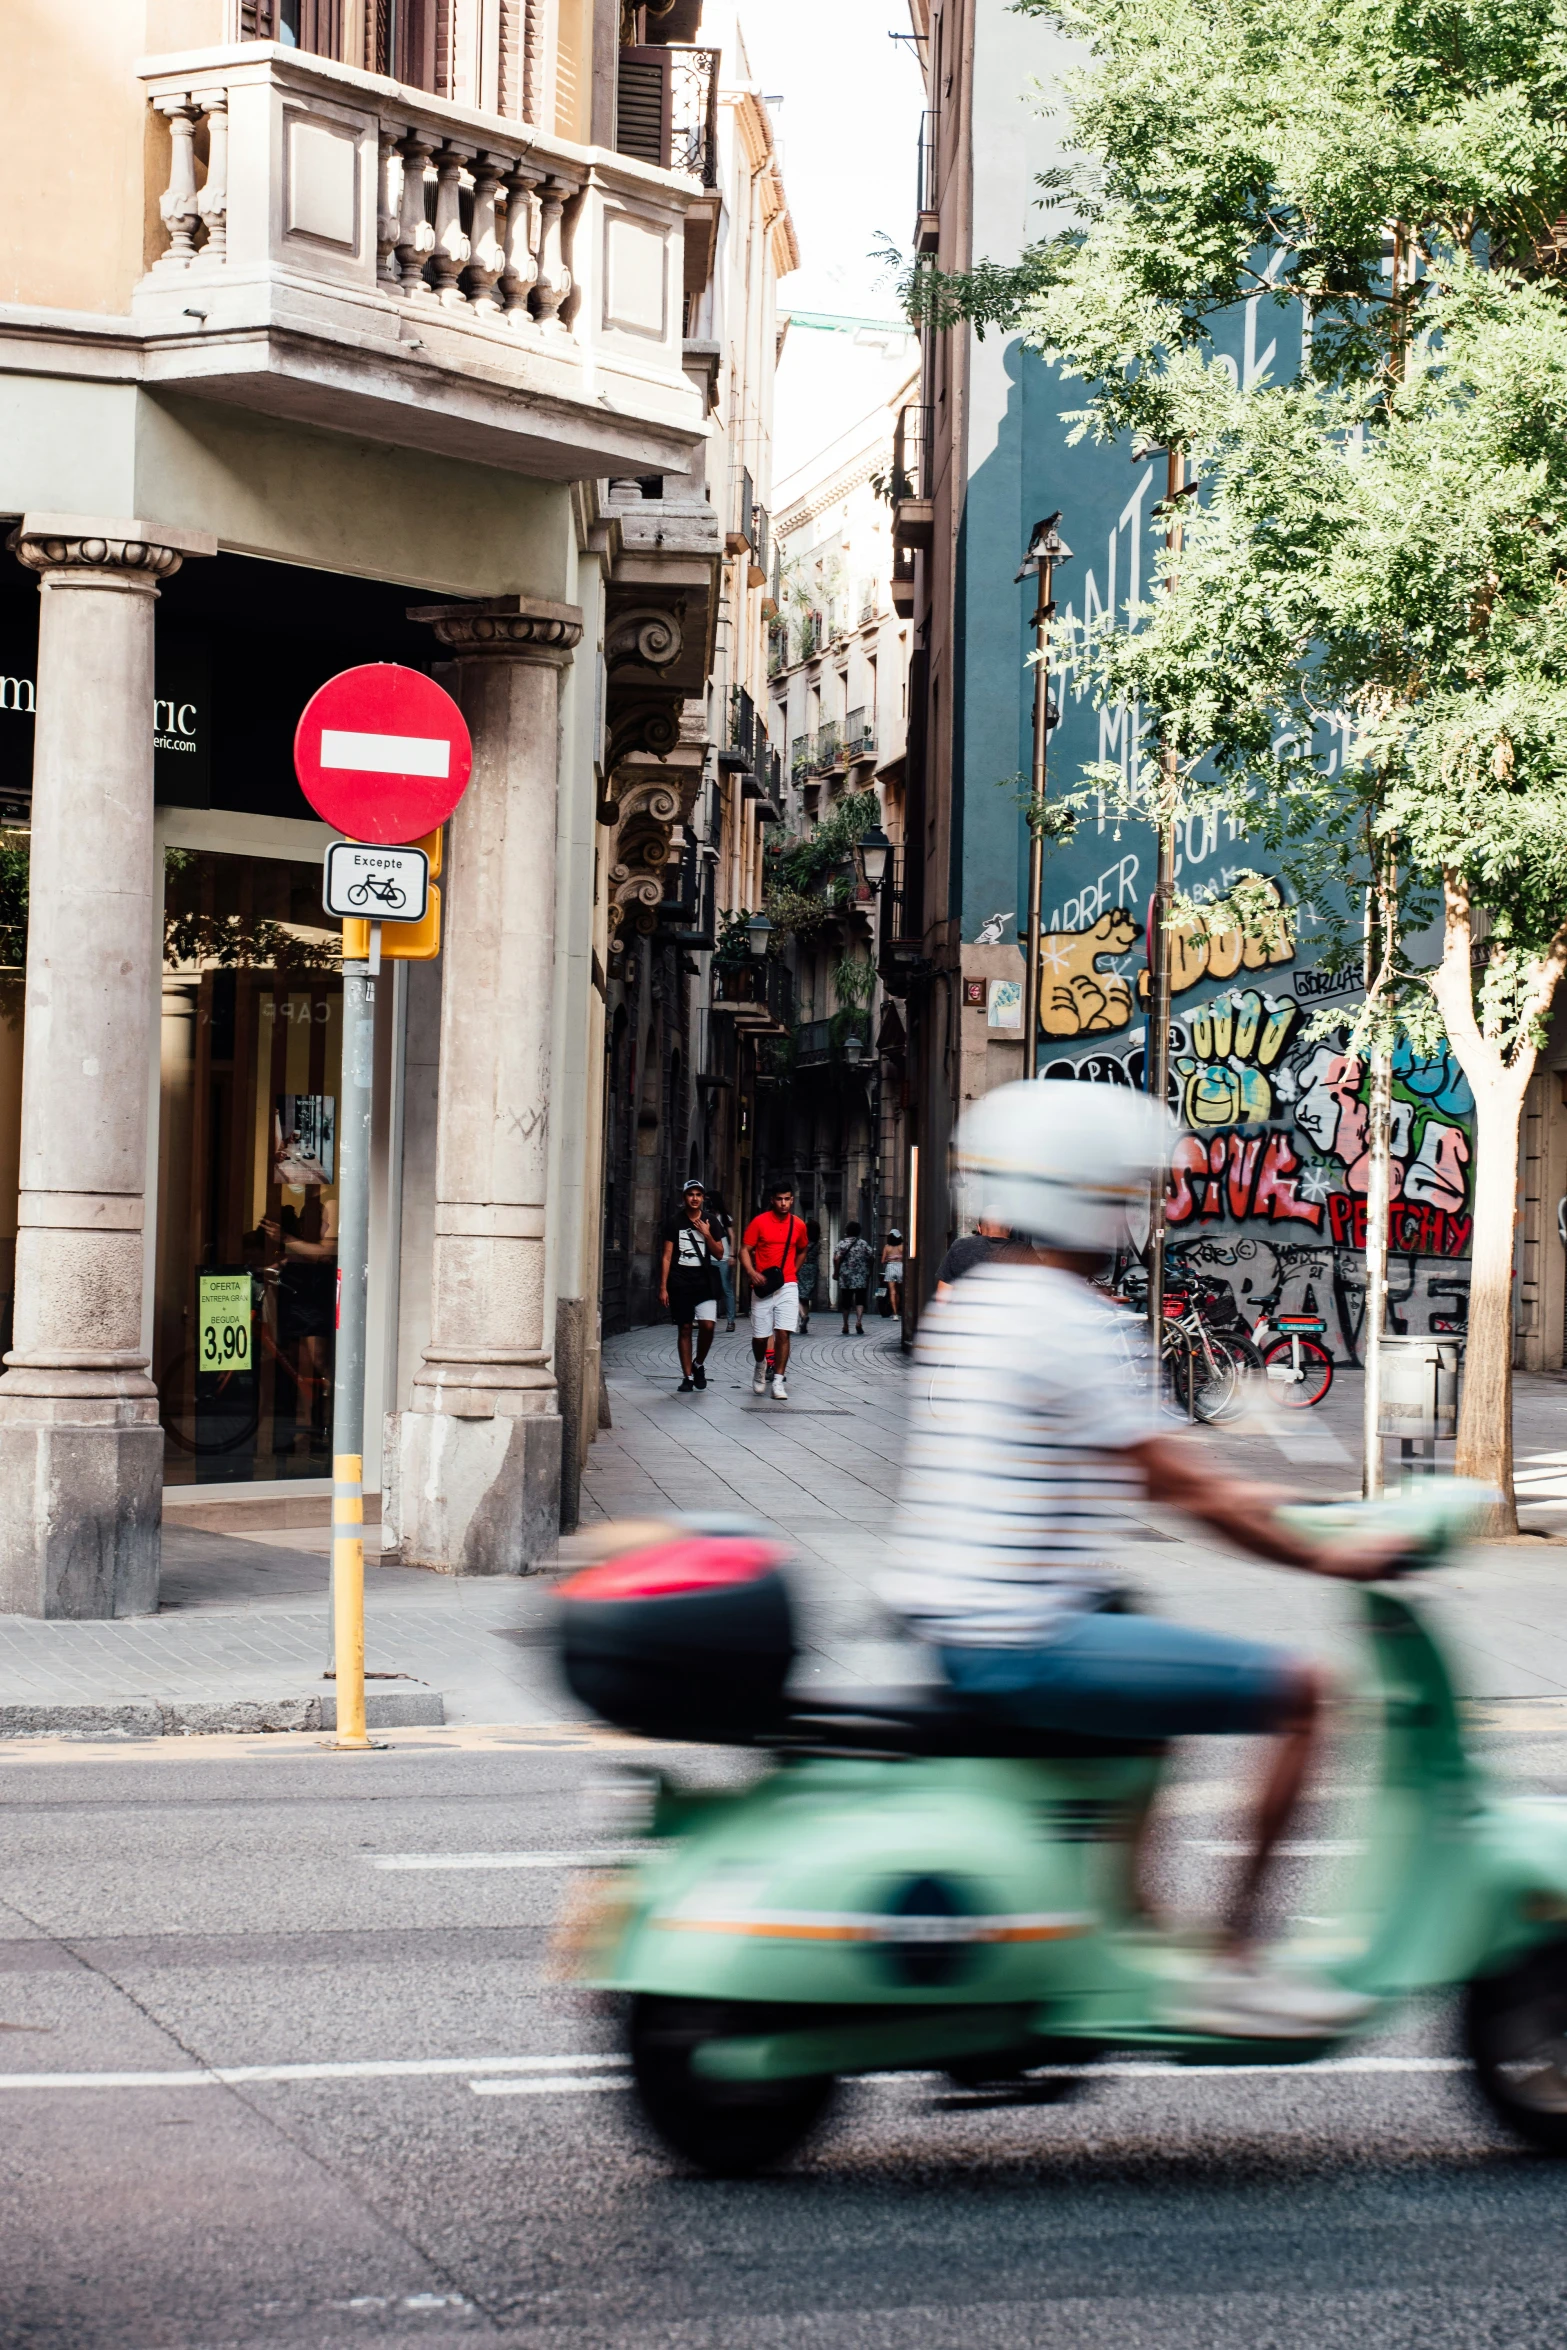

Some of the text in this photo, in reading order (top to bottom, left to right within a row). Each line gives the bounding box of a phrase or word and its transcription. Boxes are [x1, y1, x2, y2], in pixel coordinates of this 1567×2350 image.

[354, 855, 403, 869] Excepte
[210, 1282, 241, 1291] OFERTA
[210, 1315, 240, 1324] BEGUDA
[204, 1325, 248, 1365] 3,90
